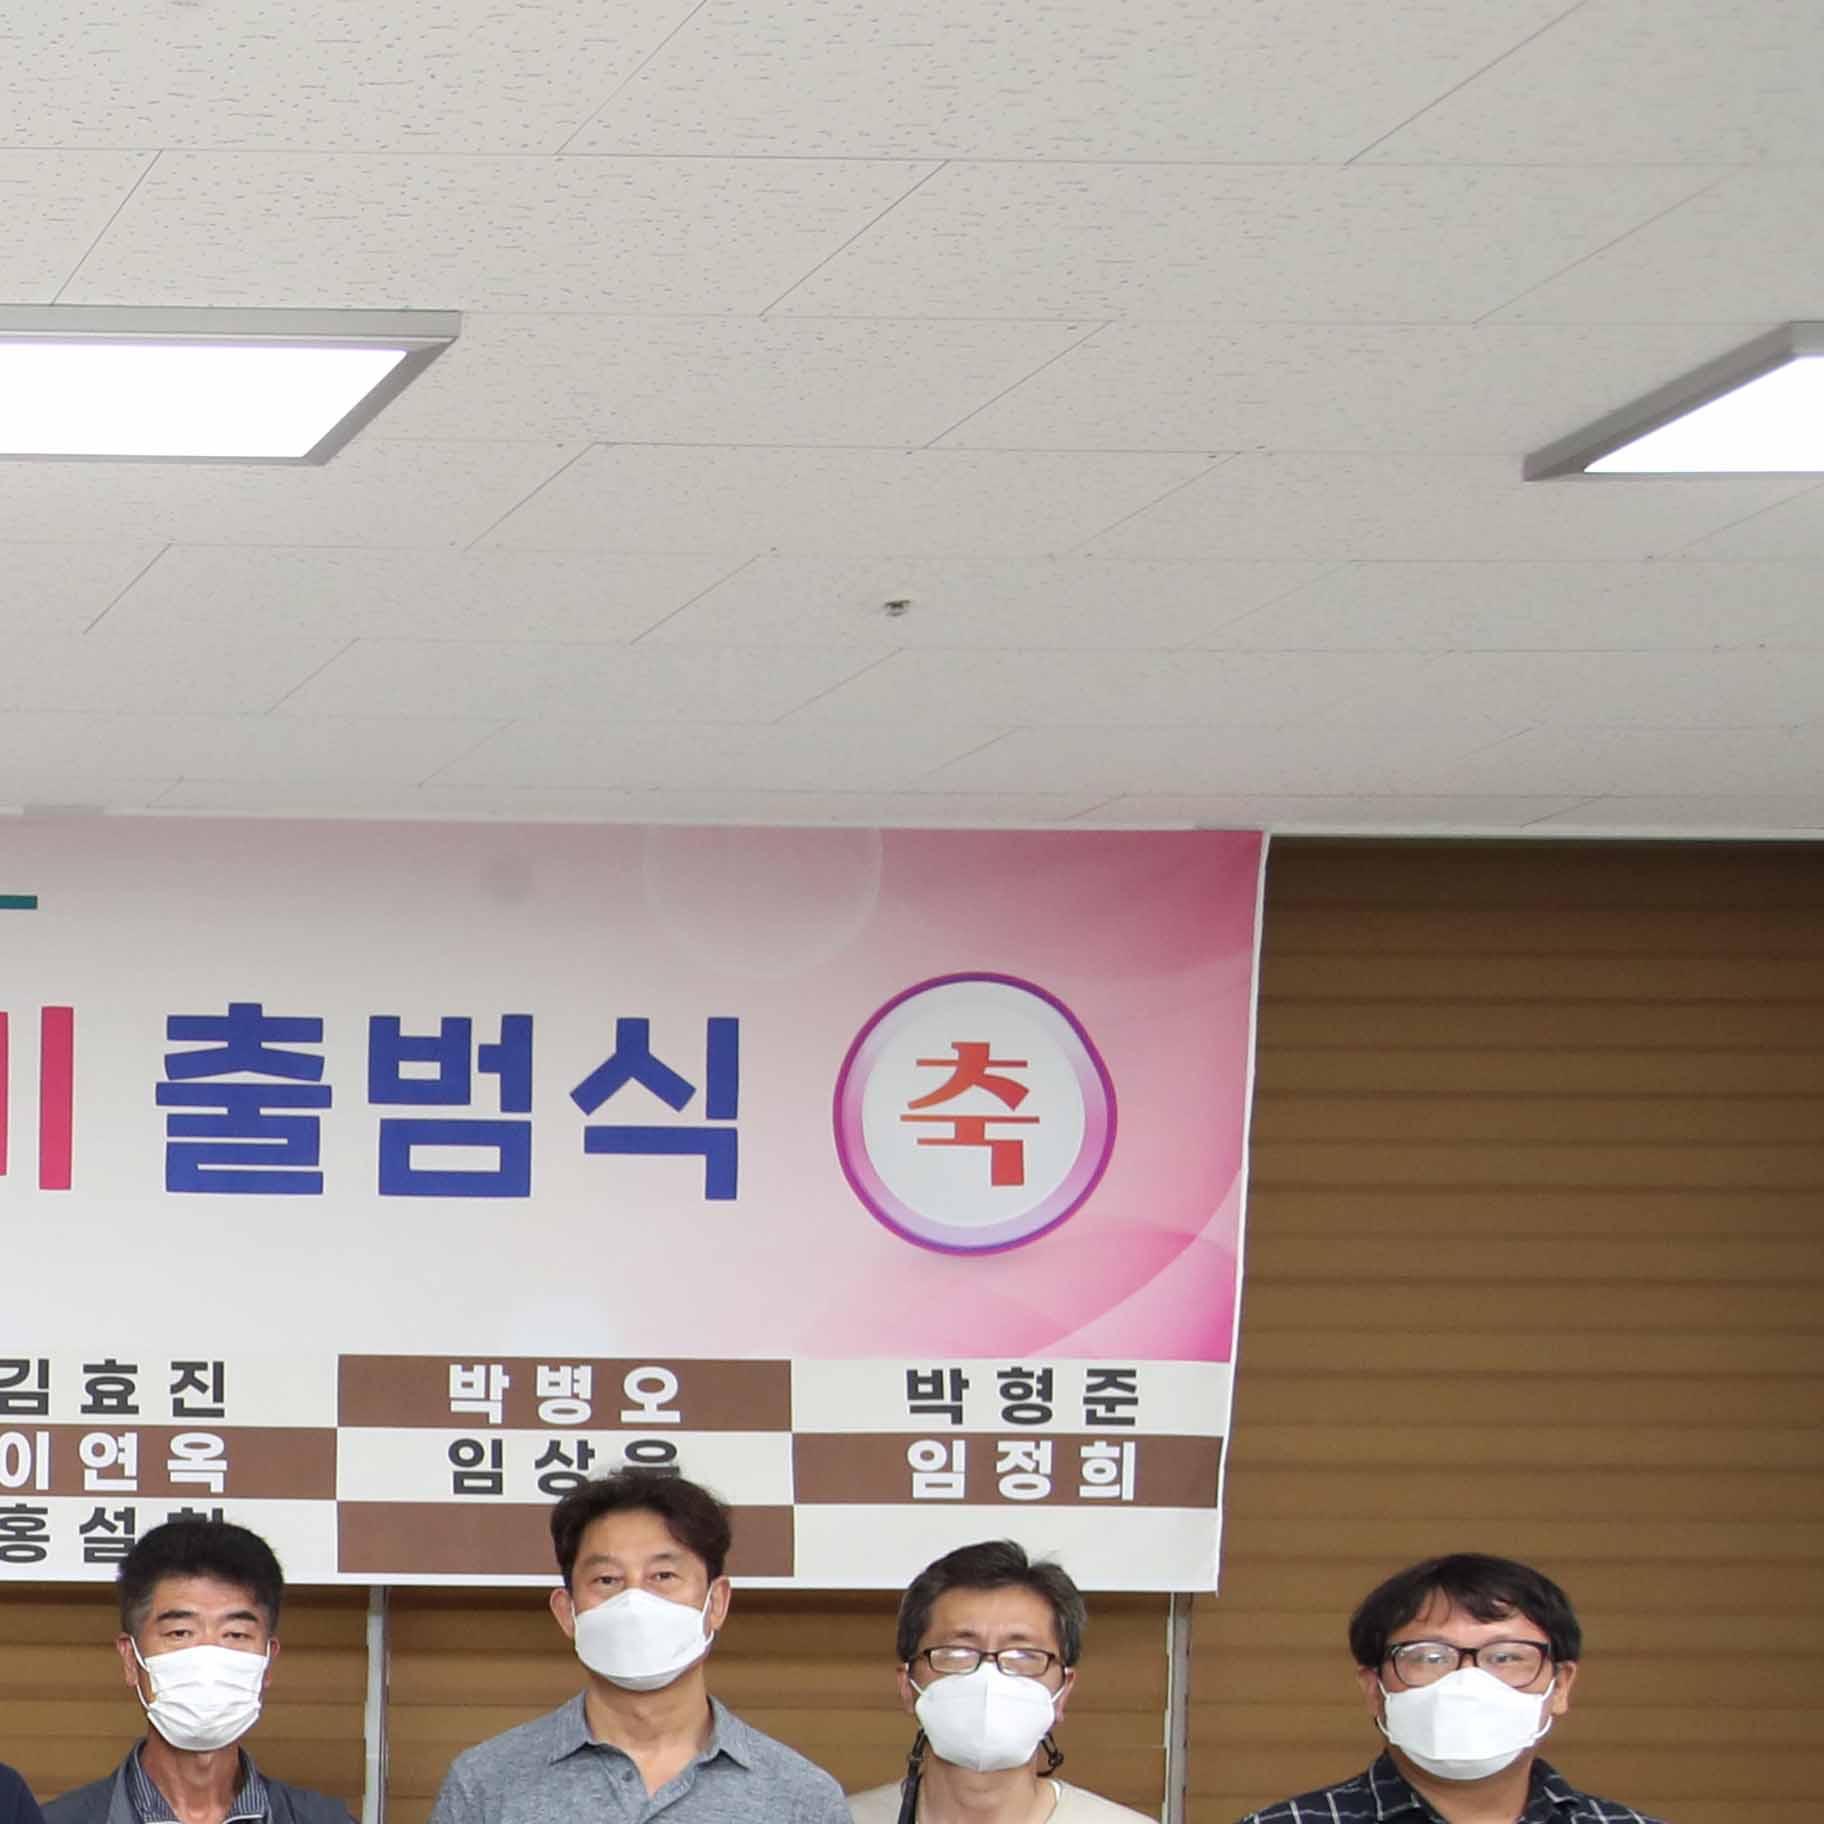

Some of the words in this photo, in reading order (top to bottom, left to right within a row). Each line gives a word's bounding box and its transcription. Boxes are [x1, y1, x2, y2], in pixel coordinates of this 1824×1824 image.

[156, 1003, 739, 1200] 출범식
[901, 1042, 1040, 1186] 축
[450, 1365, 680, 1424] 박병오
[907, 1367, 1138, 1426] 박형준
[908, 1440, 1135, 1500] 임정희
